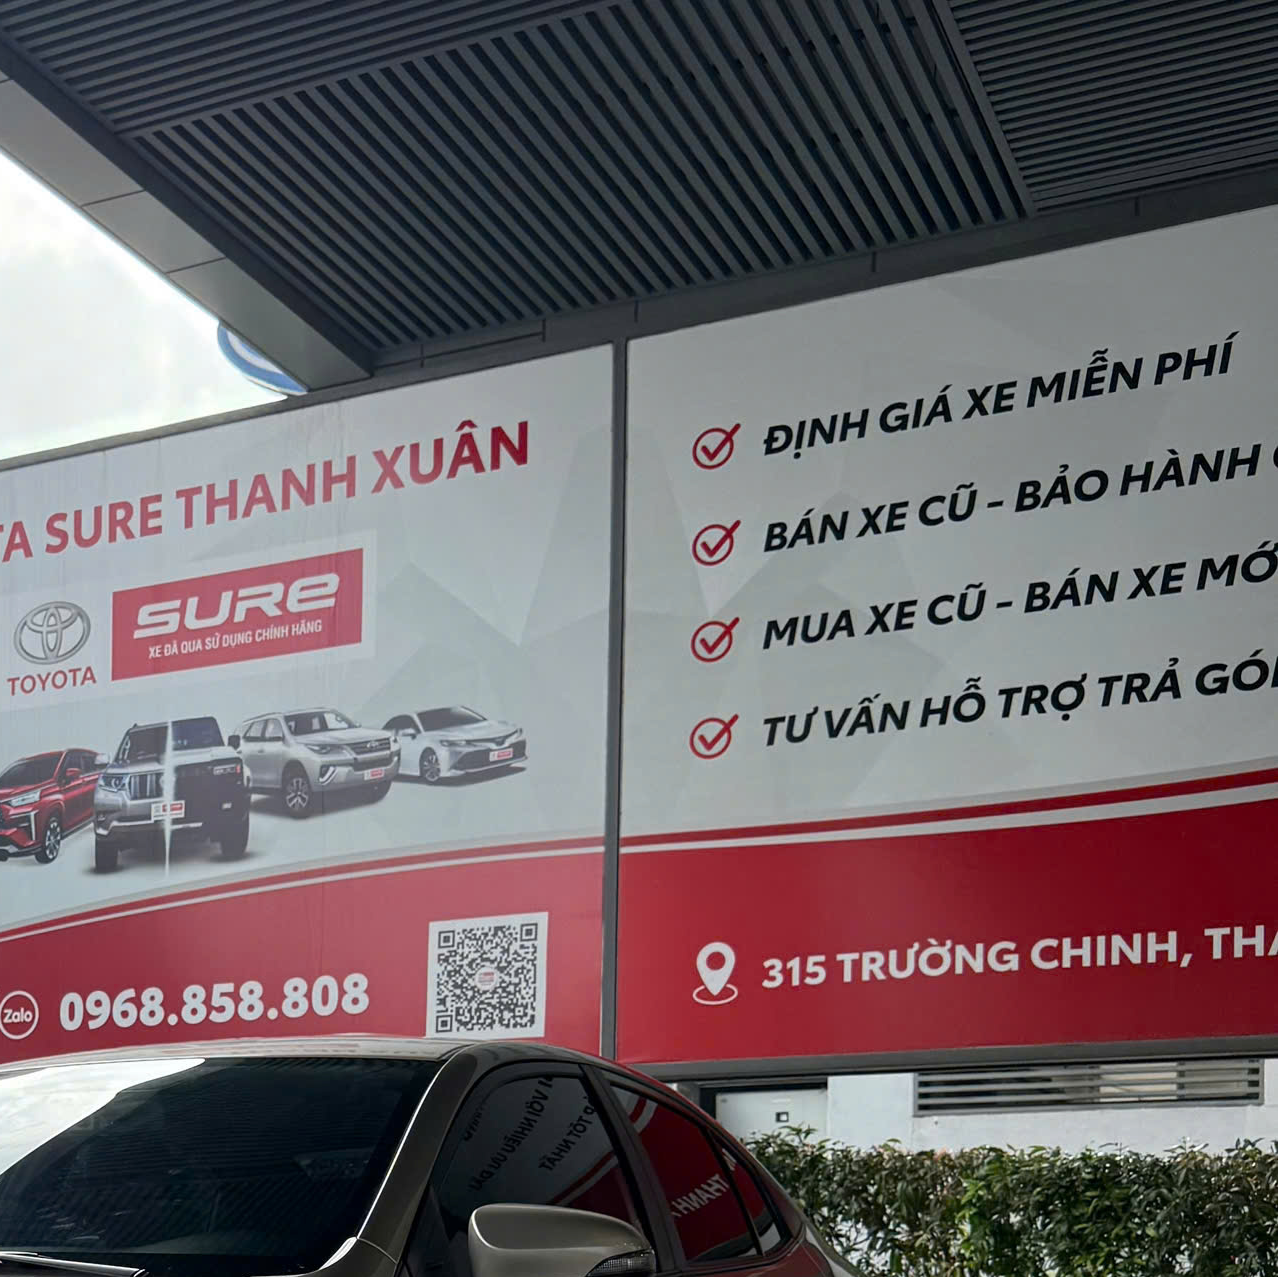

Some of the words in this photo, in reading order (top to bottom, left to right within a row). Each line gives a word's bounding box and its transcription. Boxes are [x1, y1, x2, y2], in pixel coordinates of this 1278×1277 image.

[763, 407, 870, 460] ĐỊNH
[878, 383, 953, 434] GIÁ
[961, 380, 1019, 421] XE
[1026, 347, 1143, 409] MIỄN
[1153, 331, 1240, 387] PHÍ
[43, 493, 163, 554] SURE
[175, 455, 356, 530] THANH
[370, 418, 530, 496] XUÂN
[763, 508, 849, 553] BÁN
[855, 501, 910, 538] XE
[917, 482, 979, 527] CŨ
[1013, 464, 1109, 514] BẢO
[1119, 443, 1263, 497] HÀNH
[148, 645, 162, 659] XE
[181, 640, 202, 655] QUA
[222, 633, 252, 650] DỤNG
[255, 624, 289, 643] CHÍNH
[763, 609, 856, 651] MUA
[864, 599, 918, 636] XE
[927, 582, 987, 627] CŨ
[1023, 567, 1119, 614] BÁN
[1126, 561, 1187, 600] XE
[7, 665, 97, 698] TOYOTA
[763, 706, 820, 747] TƯ
[823, 692, 911, 739] VẤN
[919, 676, 987, 729] HỖ
[997, 673, 1087, 722] TRỢ
[1097, 657, 1183, 709] TRẢ
[1195, 648, 1278, 696] GÓ
[762, 954, 826, 989] 315
[836, 938, 1020, 983] TRƯỜNG
[1031, 931, 1193, 969] CHINH,
[2, 1008, 34, 1024] Zalo
[59, 973, 370, 1031] 0968.858.808
